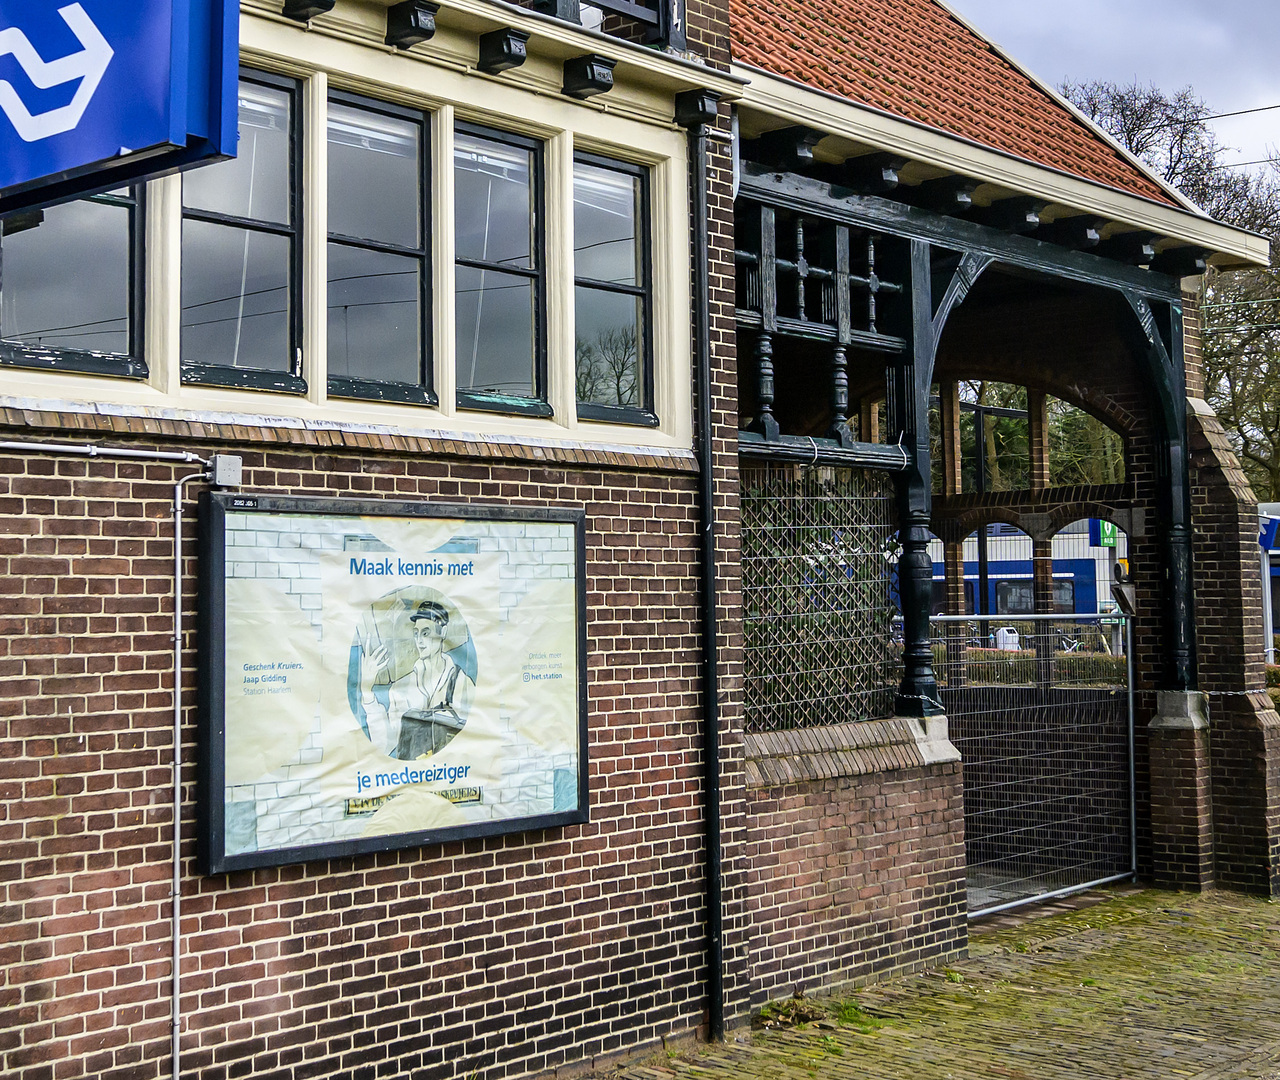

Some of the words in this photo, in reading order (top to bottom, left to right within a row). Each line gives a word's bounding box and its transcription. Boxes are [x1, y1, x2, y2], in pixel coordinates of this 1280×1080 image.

[350, 558, 394, 575] Maak
[398, 558, 443, 576] kennis
[447, 561, 474, 575] met
[243, 662, 275, 671] Geschenk
[277, 662, 304, 670] Kruiers,
[243, 675, 260, 684] Jaap
[261, 674, 287, 683] Gidding
[243, 687, 265, 695] Station
[357, 771, 371, 793] je
[376, 763, 471, 787] medereiziger
